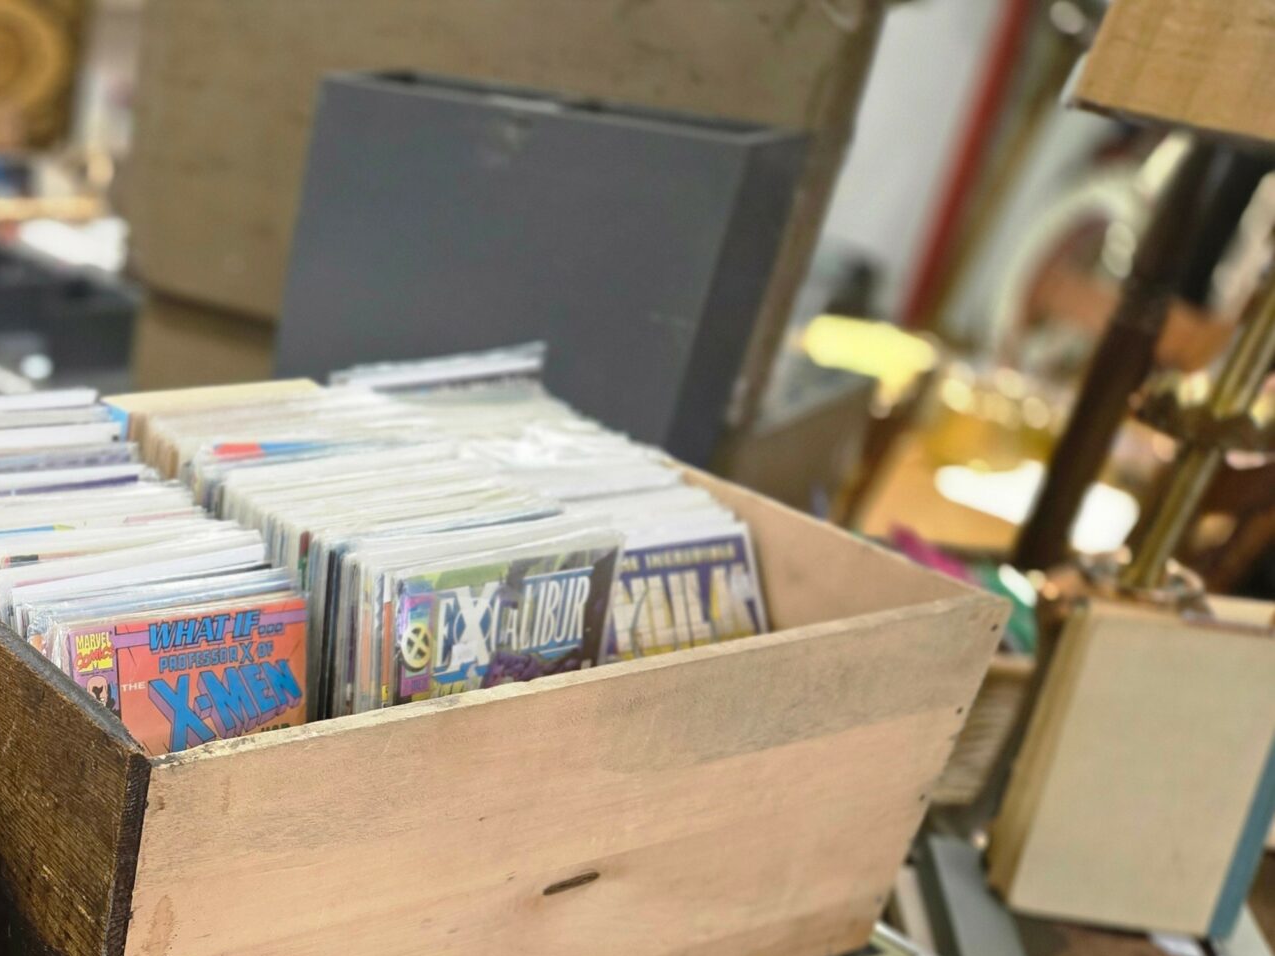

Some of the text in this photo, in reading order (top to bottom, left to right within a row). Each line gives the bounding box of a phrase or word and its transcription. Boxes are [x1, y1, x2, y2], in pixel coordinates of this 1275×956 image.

[75, 632, 112, 654] MARVEL
[148, 613, 231, 653] WHAT
[159, 640, 274, 674] PROFESSOR X OF
[122, 681, 147, 693] THE
[148, 658, 303, 754] X-MEN
